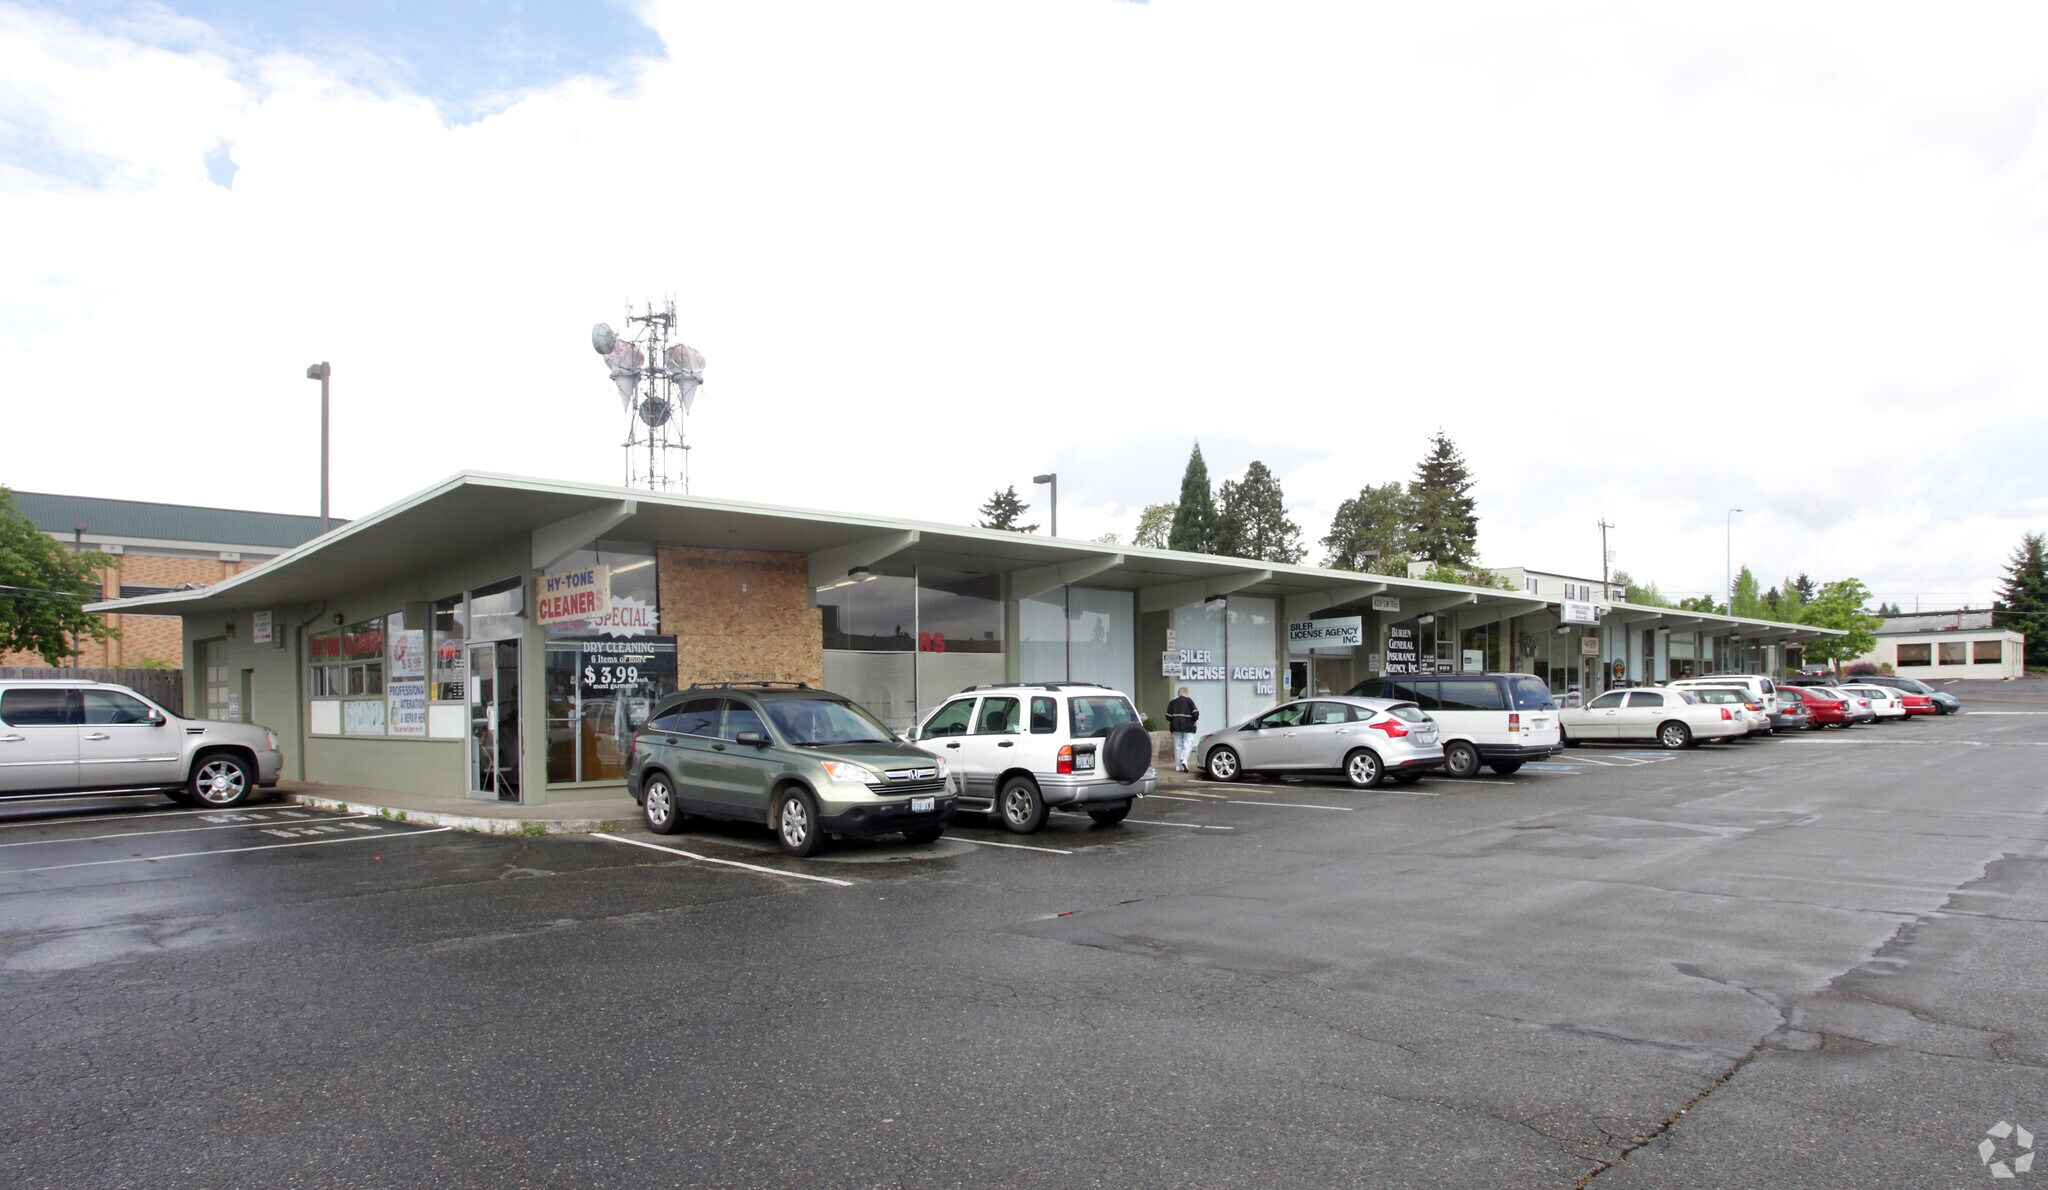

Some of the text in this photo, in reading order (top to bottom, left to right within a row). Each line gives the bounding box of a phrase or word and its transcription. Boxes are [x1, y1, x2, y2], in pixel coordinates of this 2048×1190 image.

[548, 570, 594, 592] HY-TONE
[540, 589, 603, 619] CLEANERS
[1290, 627, 1359, 639] LICENSE AGENCY
[1391, 627, 1411, 638] BURIEN
[1342, 636, 1359, 644] INC.
[1388, 639, 1414, 650] GENERAL
[583, 642, 655, 653] DRY CLEANING
[591, 655, 596, 663] 6
[598, 655, 617, 663] Items
[1180, 649, 1211, 663] SILER
[1386, 650, 1416, 661] INSURANCE
[1180, 666, 1276, 680] LICENSE AGENCY
[1257, 682, 1276, 694] Inc.
